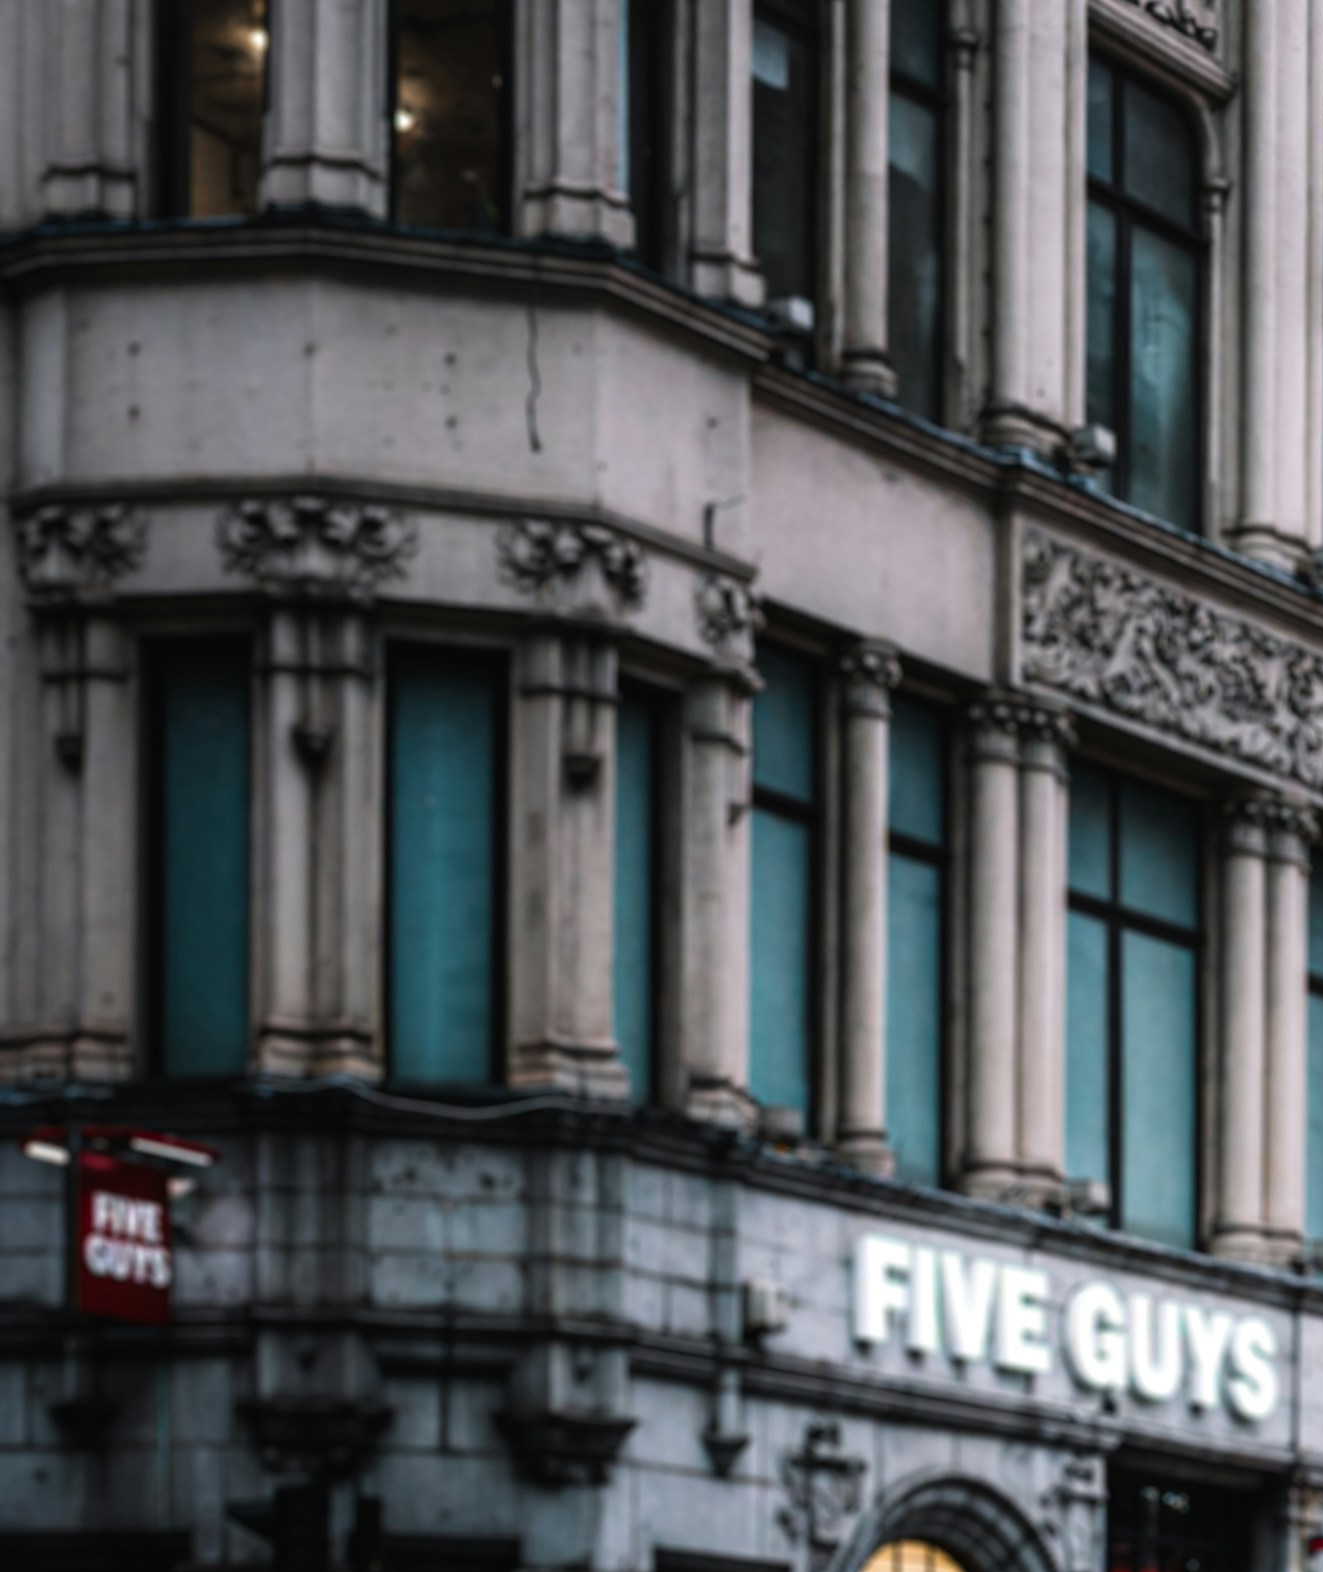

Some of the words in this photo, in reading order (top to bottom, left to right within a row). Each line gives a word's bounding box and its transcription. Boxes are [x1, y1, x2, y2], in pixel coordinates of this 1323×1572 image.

[91, 1191, 164, 1244] FIVE
[84, 1234, 171, 1290] GUYS
[853, 1233, 1051, 1374] FIVE
[1066, 1281, 1279, 1421] GUYS
